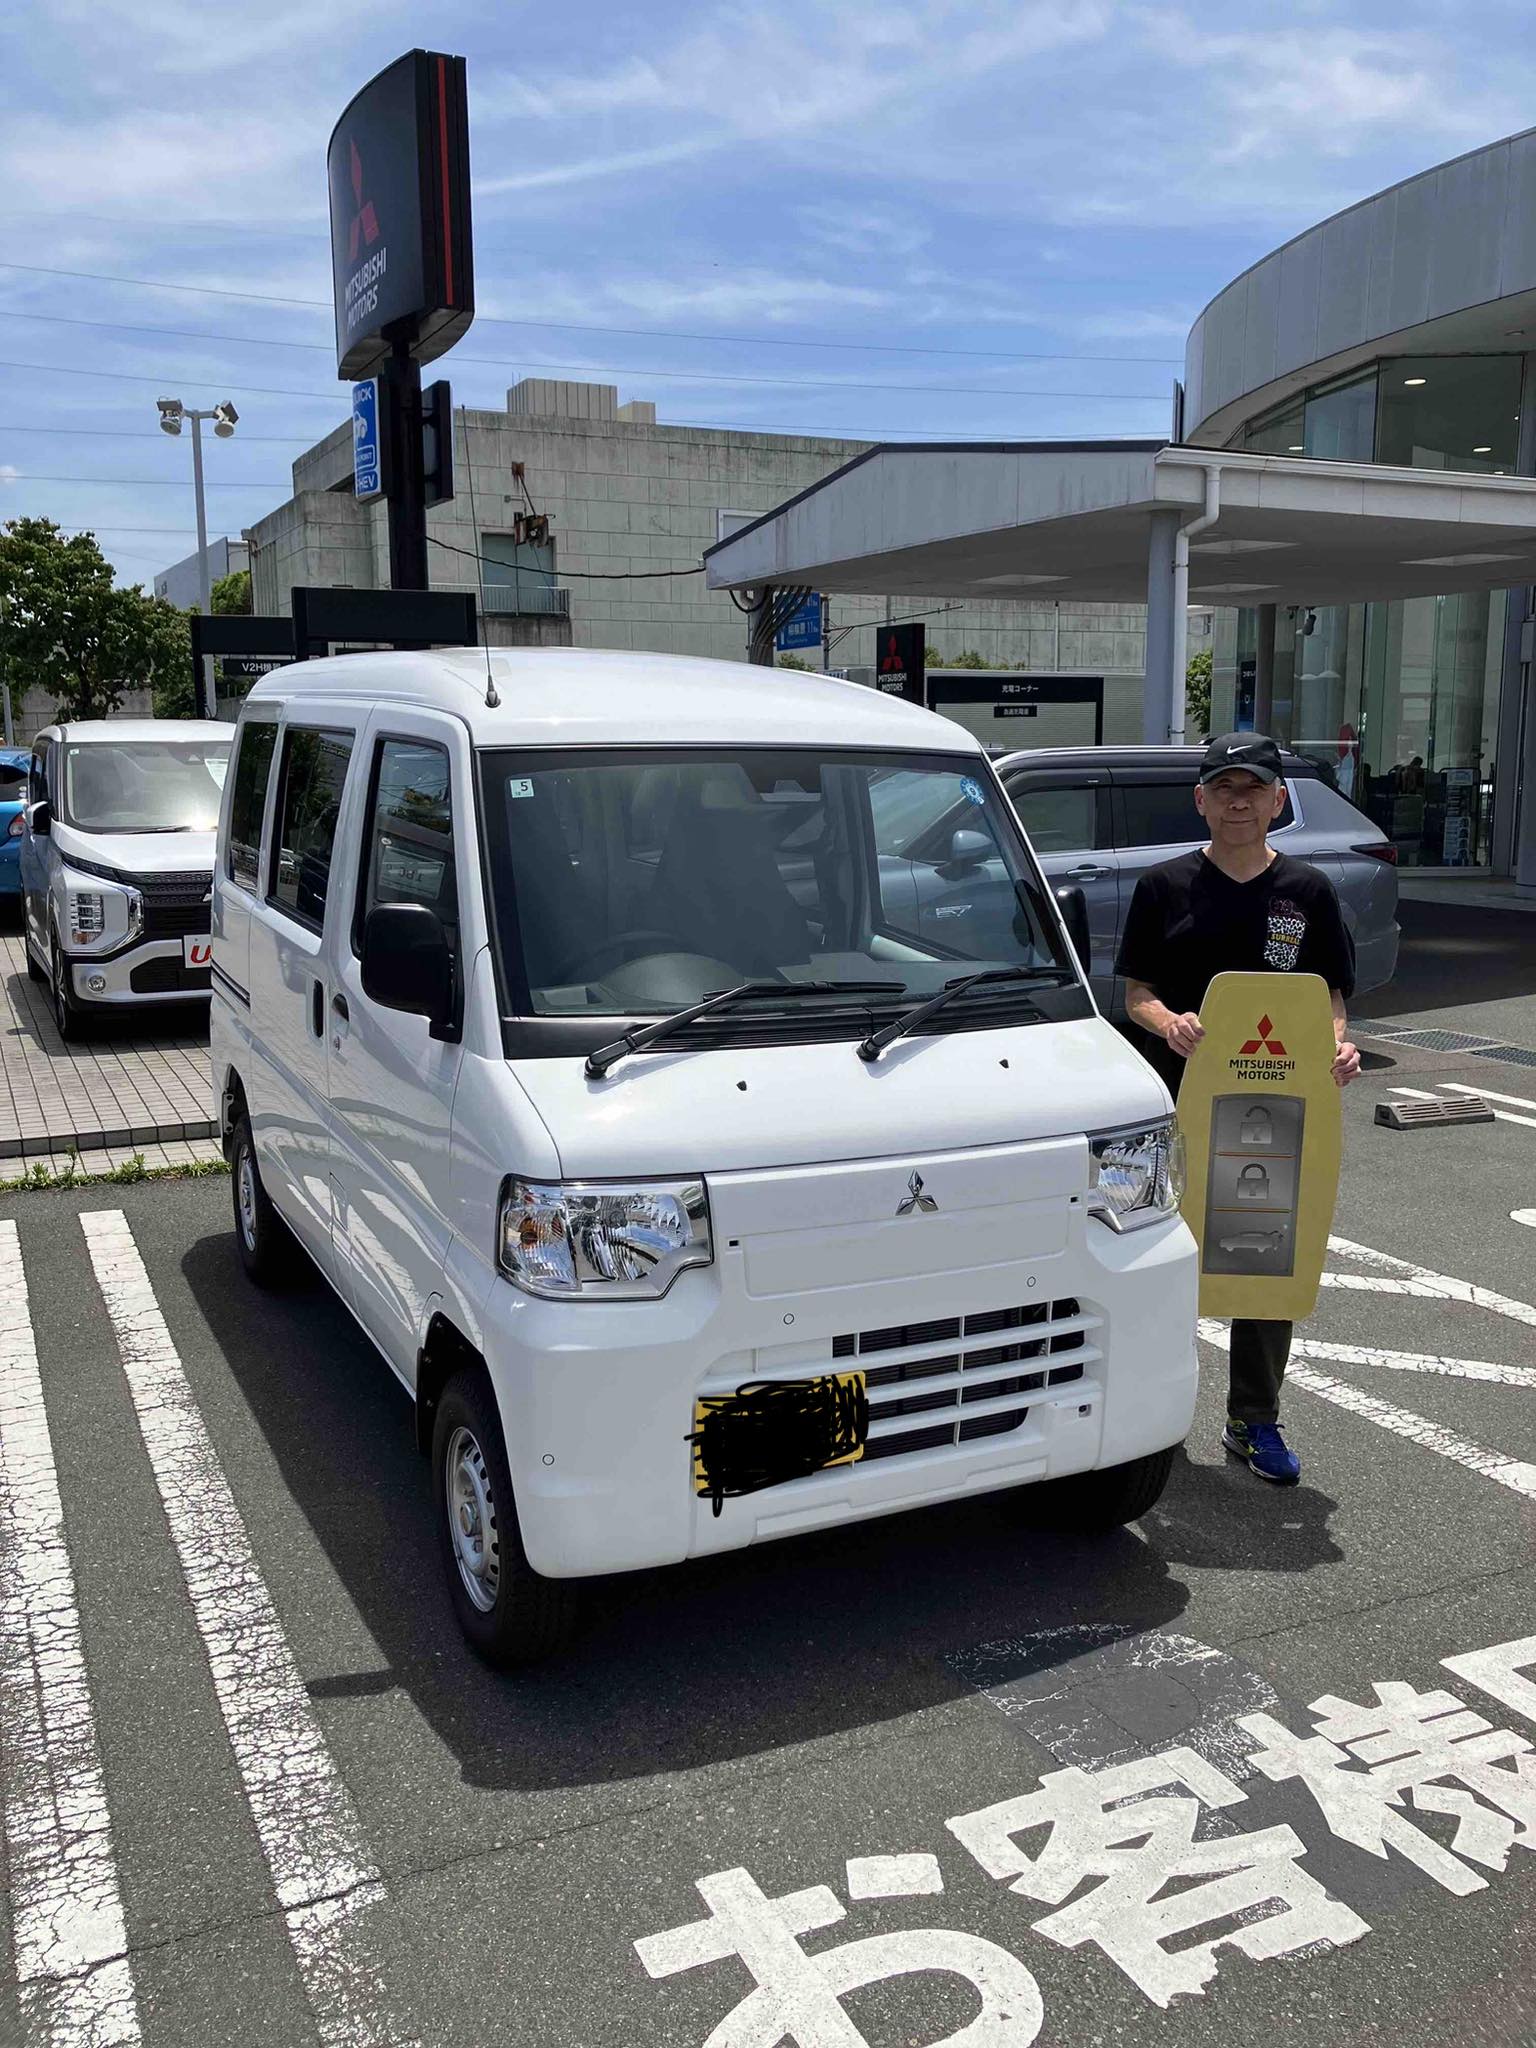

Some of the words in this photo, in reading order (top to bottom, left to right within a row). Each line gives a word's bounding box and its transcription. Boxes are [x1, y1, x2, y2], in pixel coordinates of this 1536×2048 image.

[345, 247, 386, 310] MITSUBISHI
[347, 284, 378, 335] MOTORS
[878, 673, 907, 682] MITSUBISHI
[881, 683, 903, 691] MOTORS
[520, 781, 528, 791] 5
[1229, 1059, 1295, 1070] MITSUBISHI
[1237, 1070, 1286, 1080] MOTORS
[633, 1635, 1536, 2048] お客様
